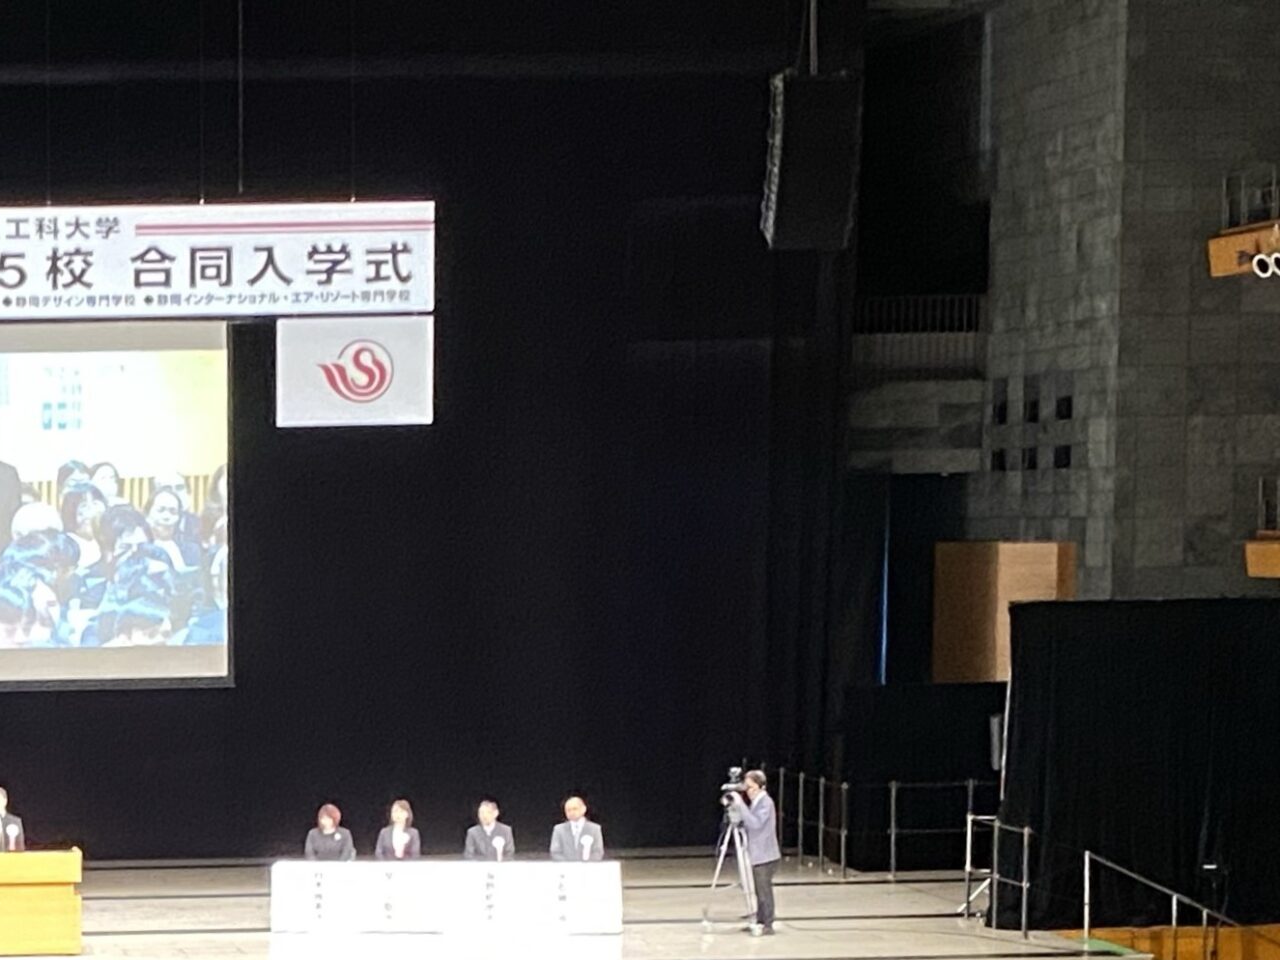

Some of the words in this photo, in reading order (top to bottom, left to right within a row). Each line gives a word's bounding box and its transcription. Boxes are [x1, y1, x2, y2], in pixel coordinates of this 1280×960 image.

[129, 242, 413, 288] 合同入学式
